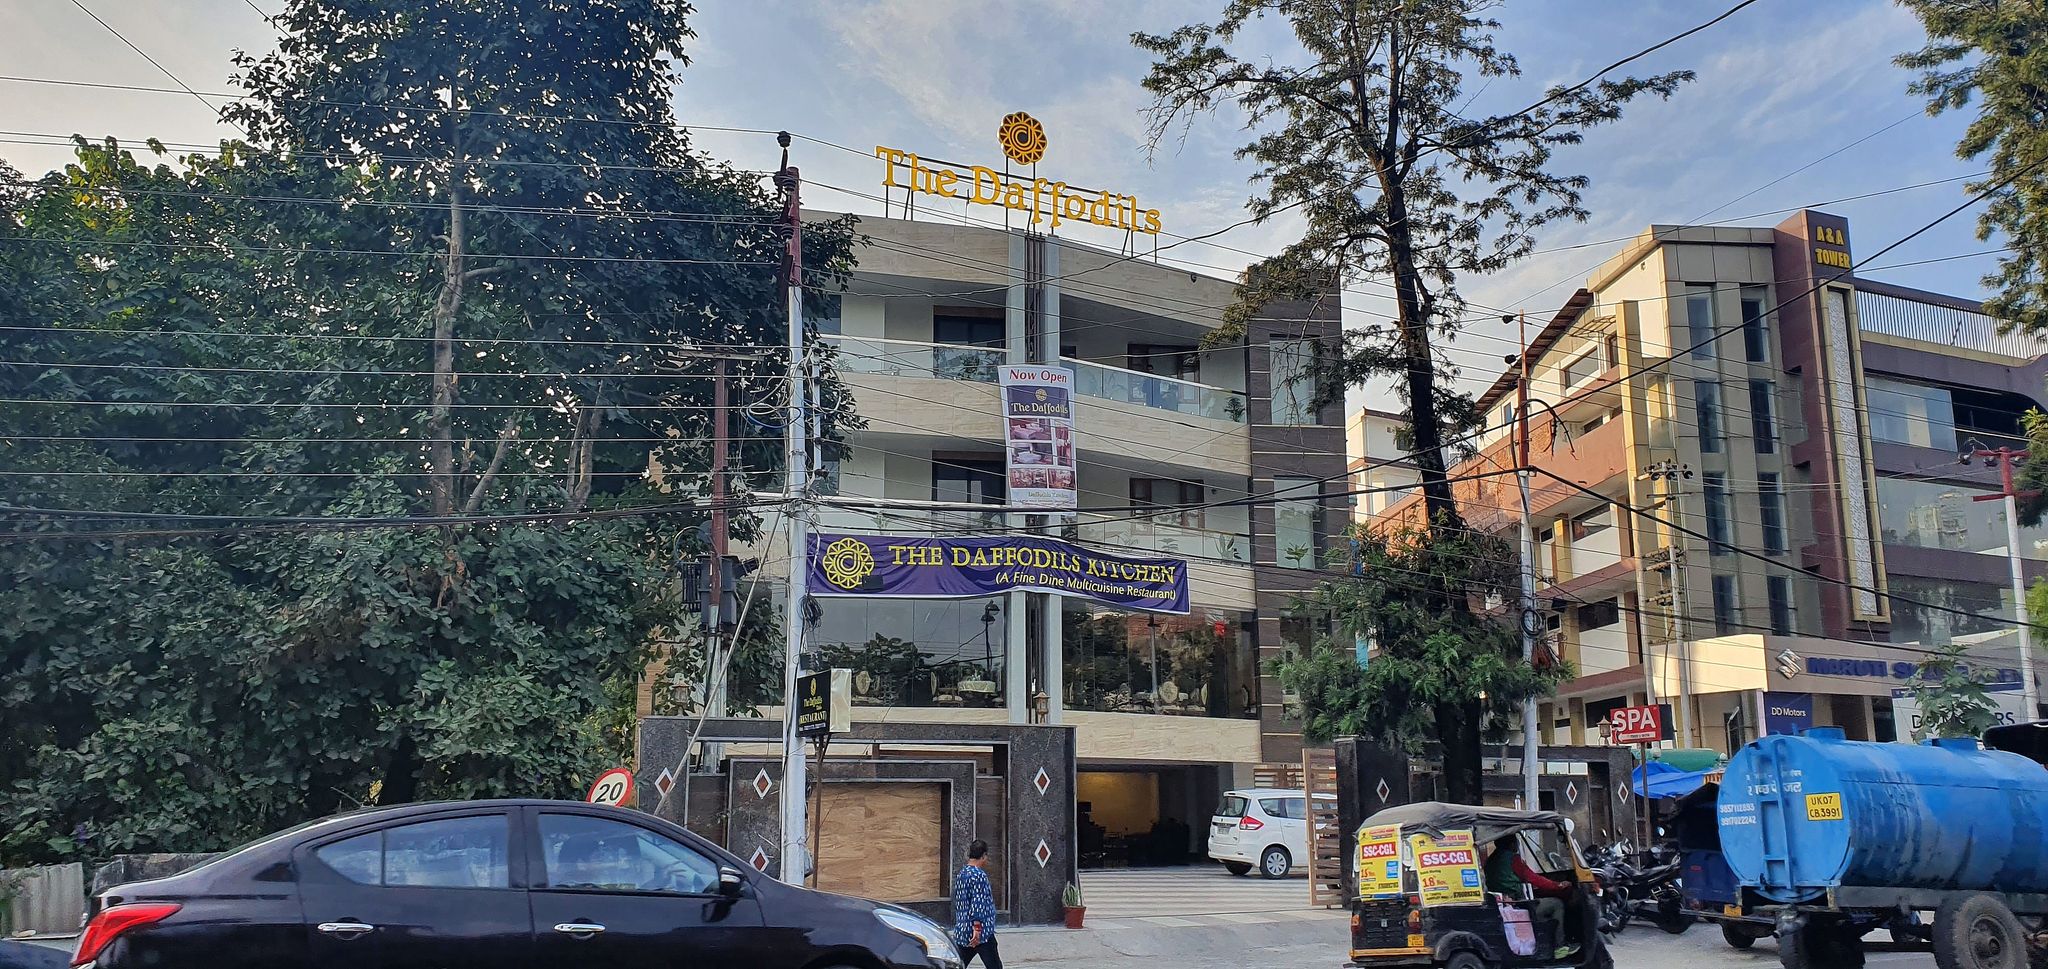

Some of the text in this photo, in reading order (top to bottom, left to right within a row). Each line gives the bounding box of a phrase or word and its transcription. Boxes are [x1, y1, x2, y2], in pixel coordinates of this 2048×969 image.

[876, 145, 1162, 234] The Daffodils
[1815, 248, 1850, 269] TOWER
[1009, 369, 1067, 383] Now Open
[1011, 402, 1068, 414] The Daffodils
[888, 545, 1175, 584] THE DAFFODILS KITCHEN
[995, 571, 1176, 600] (A Fine Dine Multicuisine Restaurant)
[1806, 657, 1888, 676] MARUTI
[1613, 707, 1657, 732] SPA
[1771, 707, 1807, 717] DD Motors
[595, 782, 624, 803] 20
[1363, 843, 1395, 857] SSC-CGL
[1422, 851, 1472, 866] SSC-CGL
